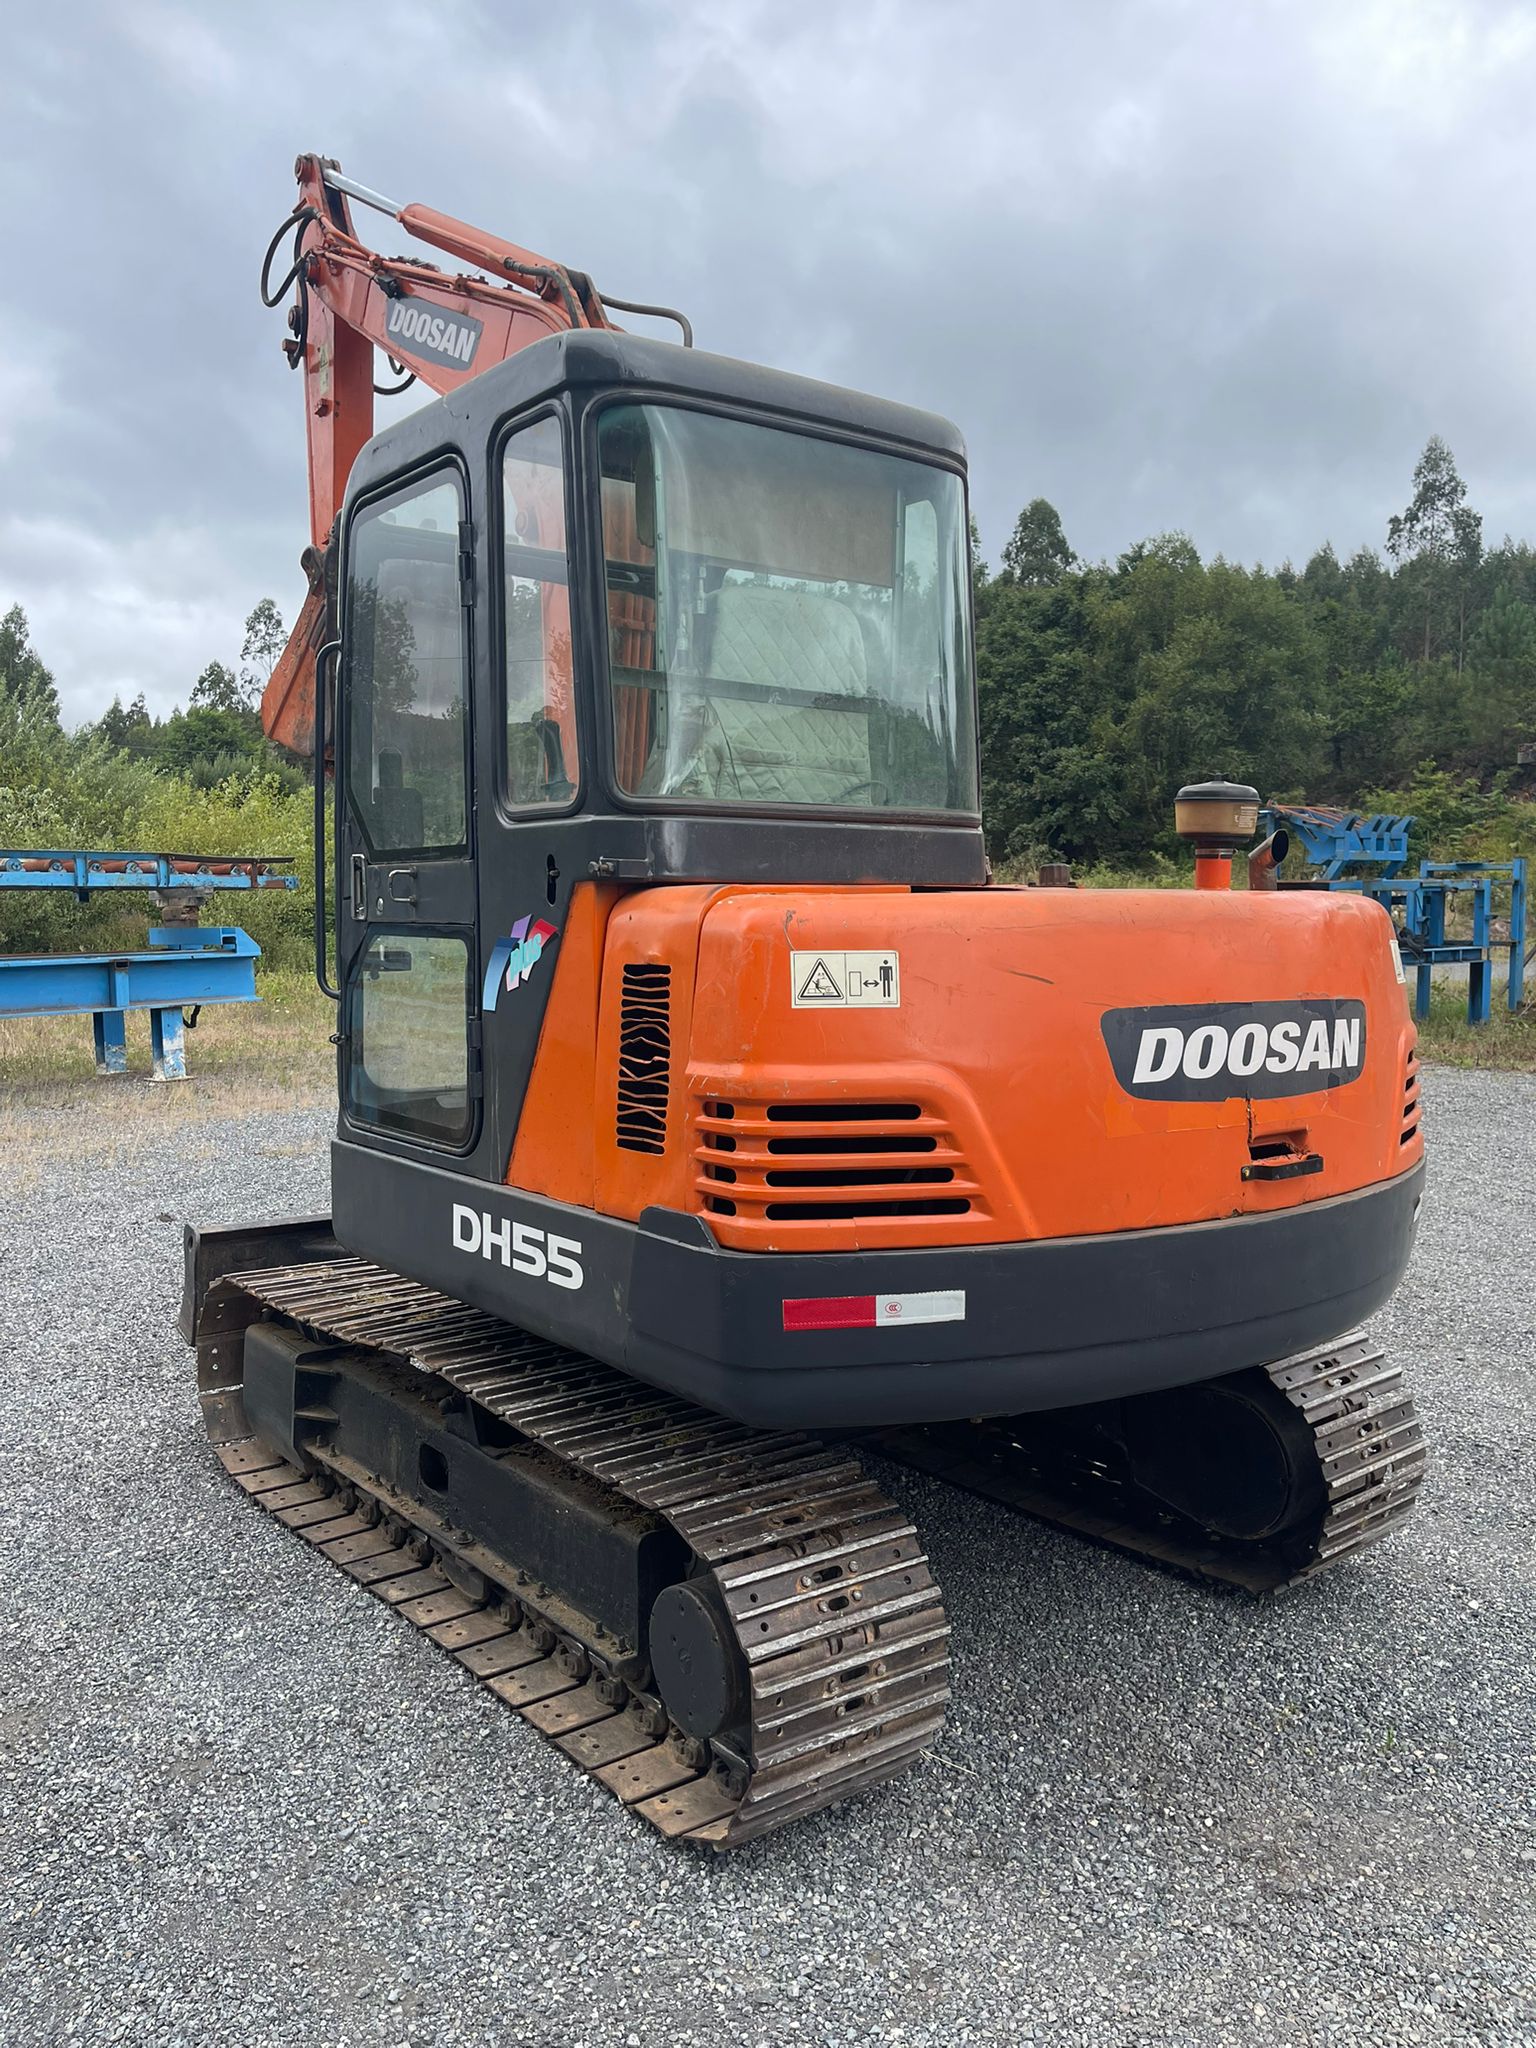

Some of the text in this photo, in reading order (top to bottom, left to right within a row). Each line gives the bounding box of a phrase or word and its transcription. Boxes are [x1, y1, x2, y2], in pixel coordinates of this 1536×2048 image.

[389, 303, 476, 362] DOOSAN
[1132, 1018, 1360, 1084] DOOSAN
[452, 1203, 584, 1290] DH55
